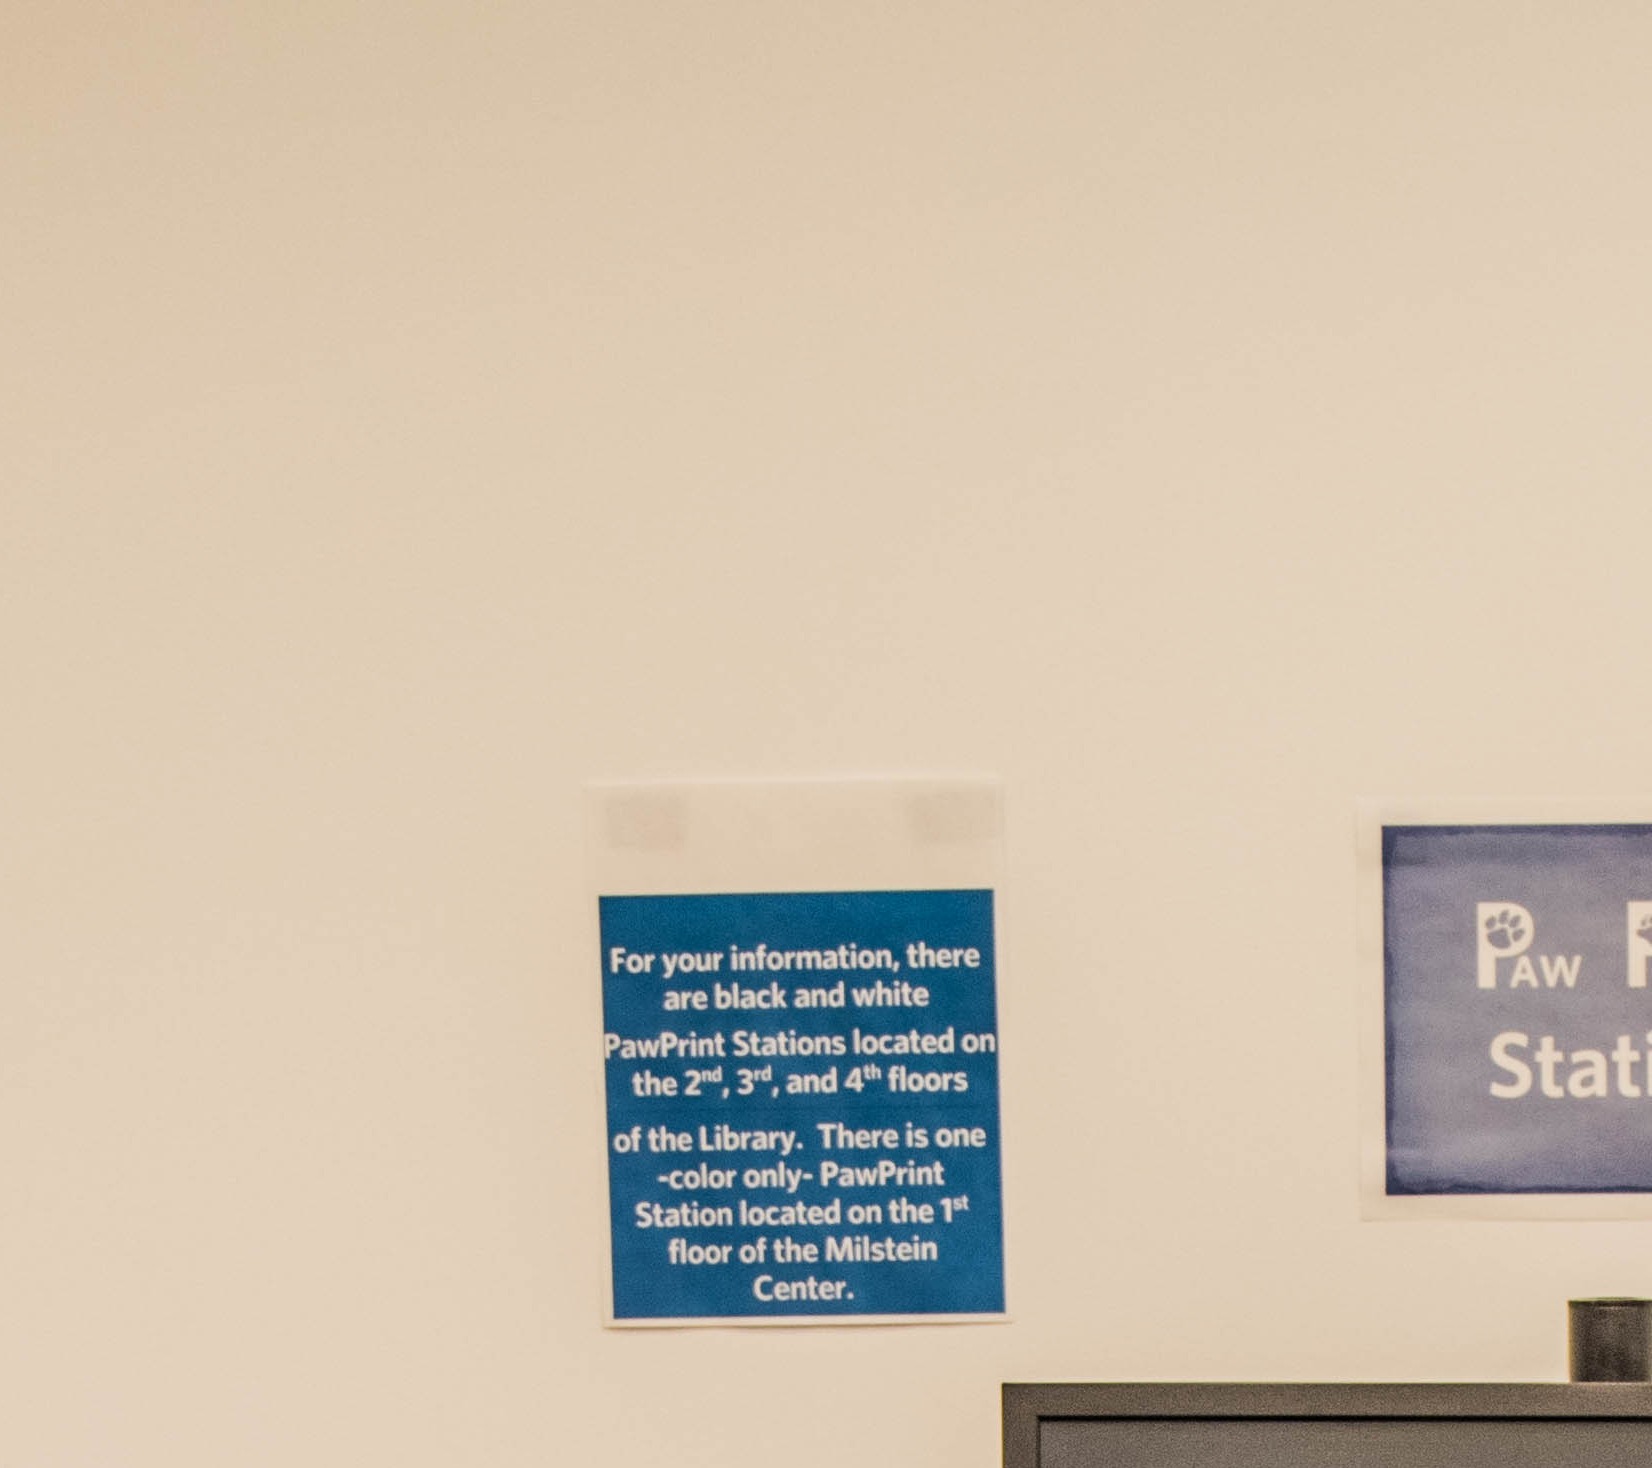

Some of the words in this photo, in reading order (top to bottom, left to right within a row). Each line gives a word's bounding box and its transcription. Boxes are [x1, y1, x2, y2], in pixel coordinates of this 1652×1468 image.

[610, 946, 656, 974] For
[662, 950, 723, 979] your
[730, 943, 902, 974] information,
[906, 941, 981, 969] there
[662, 988, 709, 1012] are
[714, 981, 788, 1010] black
[794, 981, 846, 1009] and
[852, 980, 931, 1008] white
[604, 1032, 726, 1060] PawPrint
[732, 1029, 846, 1058] Stations
[853, 1027, 954, 1055] located
[961, 1032, 997, 1054] on
[632, 1070, 678, 1097] the
[684, 1066, 730, 1099] 2nd,
[737, 1065, 780, 1099] 3rd,
[786, 1067, 838, 1094] and
[845, 1063, 882, 1093] 4th
[888, 1066, 969, 1093] floors
[613, 1126, 645, 1154] of
[648, 1126, 693, 1153] the
[699, 1124, 804, 1156] Library.
[817, 1122, 899, 1150] There
[905, 1122, 929, 1149] is
[935, 1126, 987, 1150] one
[658, 1163, 738, 1191] -color
[743, 1161, 813, 1194] only-
[820, 1160, 945, 1187] PawPrint
[635, 1201, 733, 1229] Station
[739, 1199, 841, 1227] located
[848, 1203, 883, 1227] on
[888, 1198, 934, 1225] the
[940, 1195, 970, 1223] 1st
[668, 1238, 733, 1265] floor
[739, 1237, 768, 1265] of
[773, 1236, 819, 1263] the
[825, 1234, 938, 1263] Milstein
[753, 1275, 855, 1302] Center.
